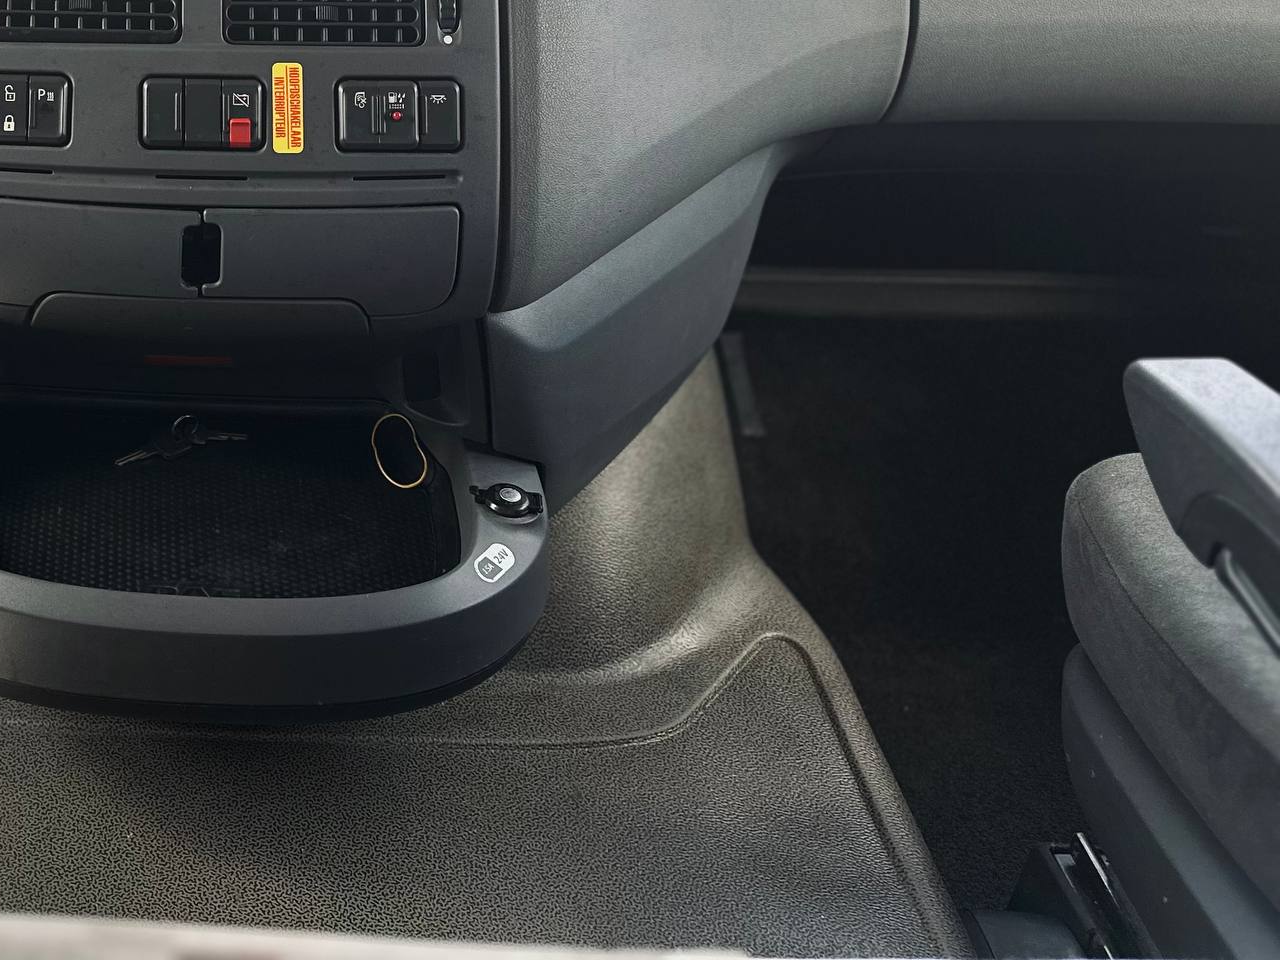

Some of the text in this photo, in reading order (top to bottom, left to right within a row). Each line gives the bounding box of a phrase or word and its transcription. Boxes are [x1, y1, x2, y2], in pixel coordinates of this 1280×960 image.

[274, 77, 286, 138] INTERRUPTEUR
[289, 67, 301, 148] HOOFDSCHAKELAAR
[494, 548, 508, 564] 24V
